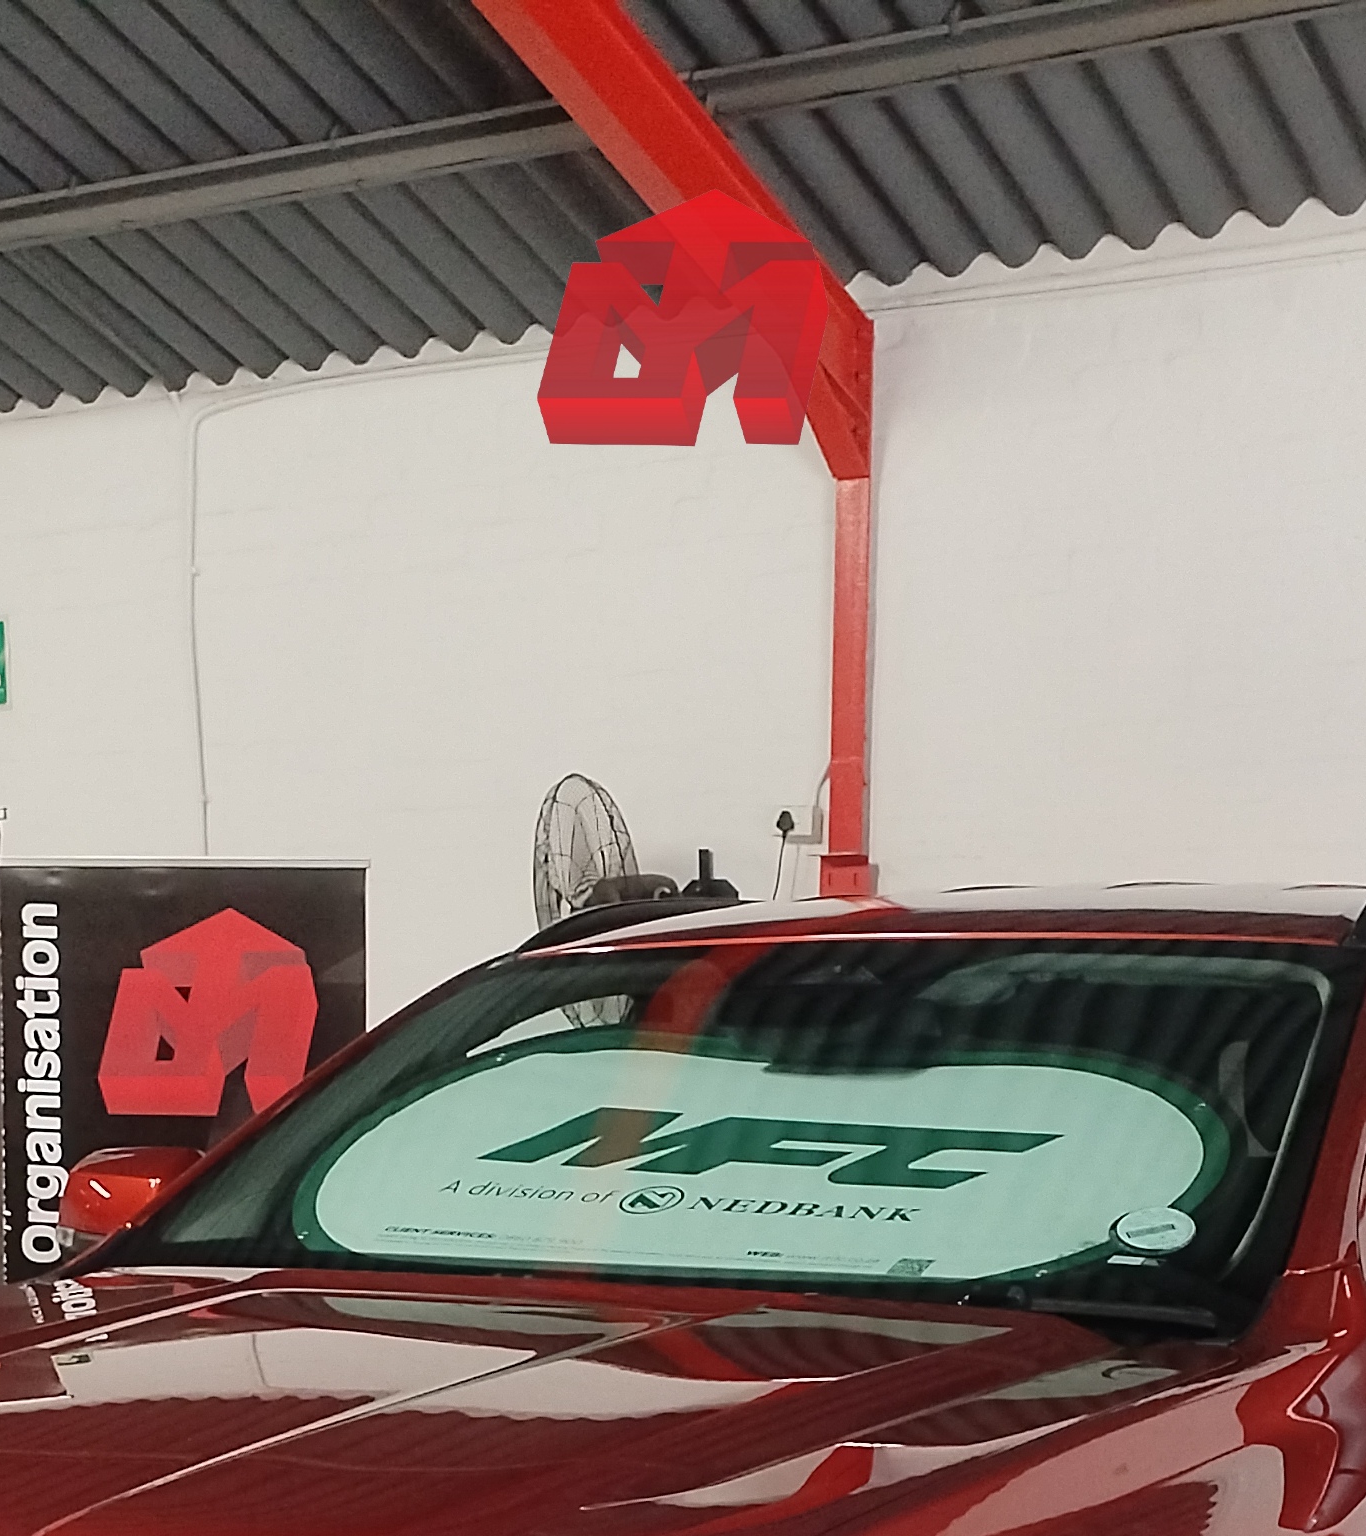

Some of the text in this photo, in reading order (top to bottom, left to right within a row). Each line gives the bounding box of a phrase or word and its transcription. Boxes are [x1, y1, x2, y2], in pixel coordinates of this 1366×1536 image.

[15, 902, 69, 1263] organisation
[477, 1106, 1064, 1190] MFC
[438, 1179, 622, 1204] A division of
[686, 1195, 922, 1222] NEDBANK
